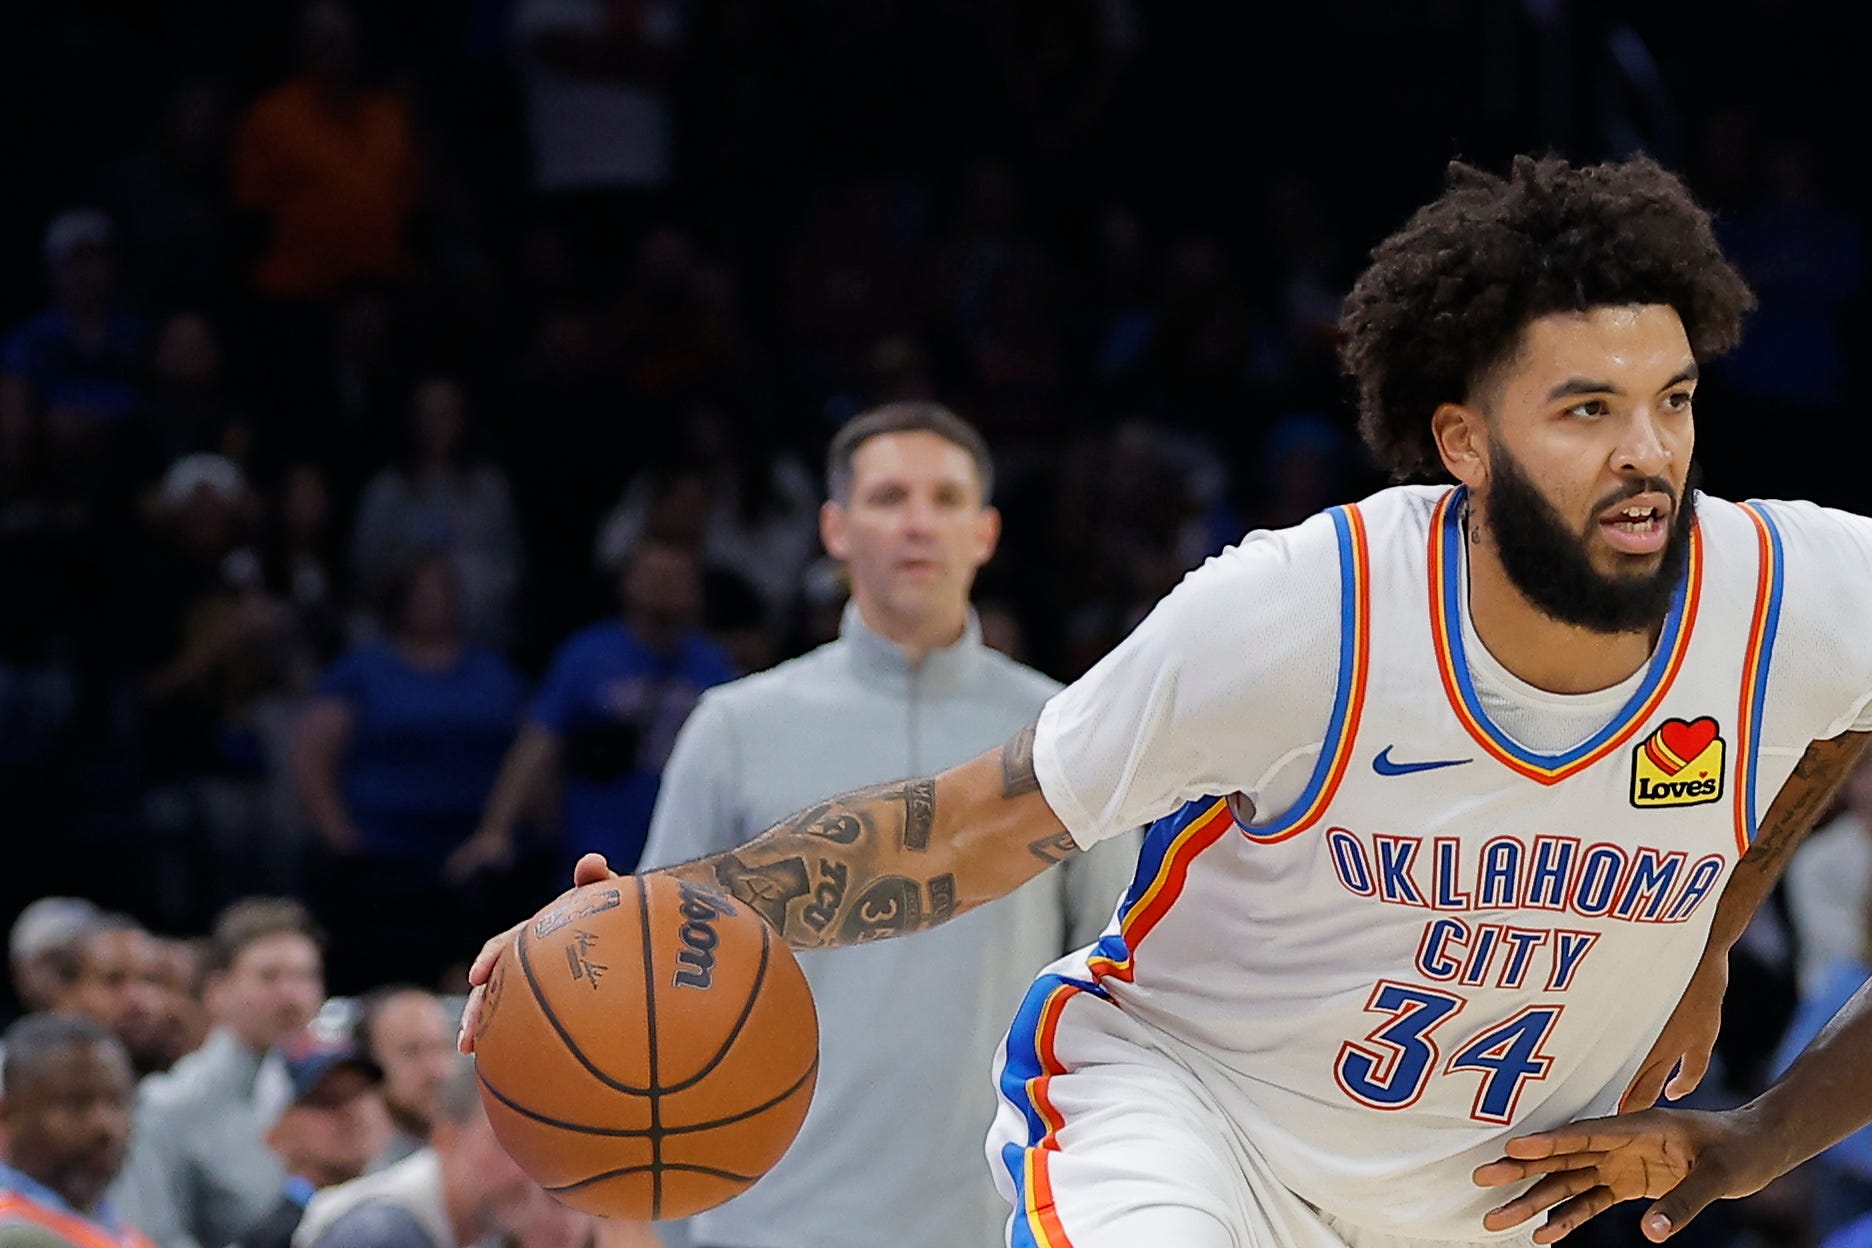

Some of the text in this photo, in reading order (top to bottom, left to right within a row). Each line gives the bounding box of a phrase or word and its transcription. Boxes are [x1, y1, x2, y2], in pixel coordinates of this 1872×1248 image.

[1326, 827, 1725, 923] OKLAHOMA
[672, 880, 738, 991] lson
[1414, 917, 1600, 992] CITY
[1333, 980, 1565, 1126] 34
